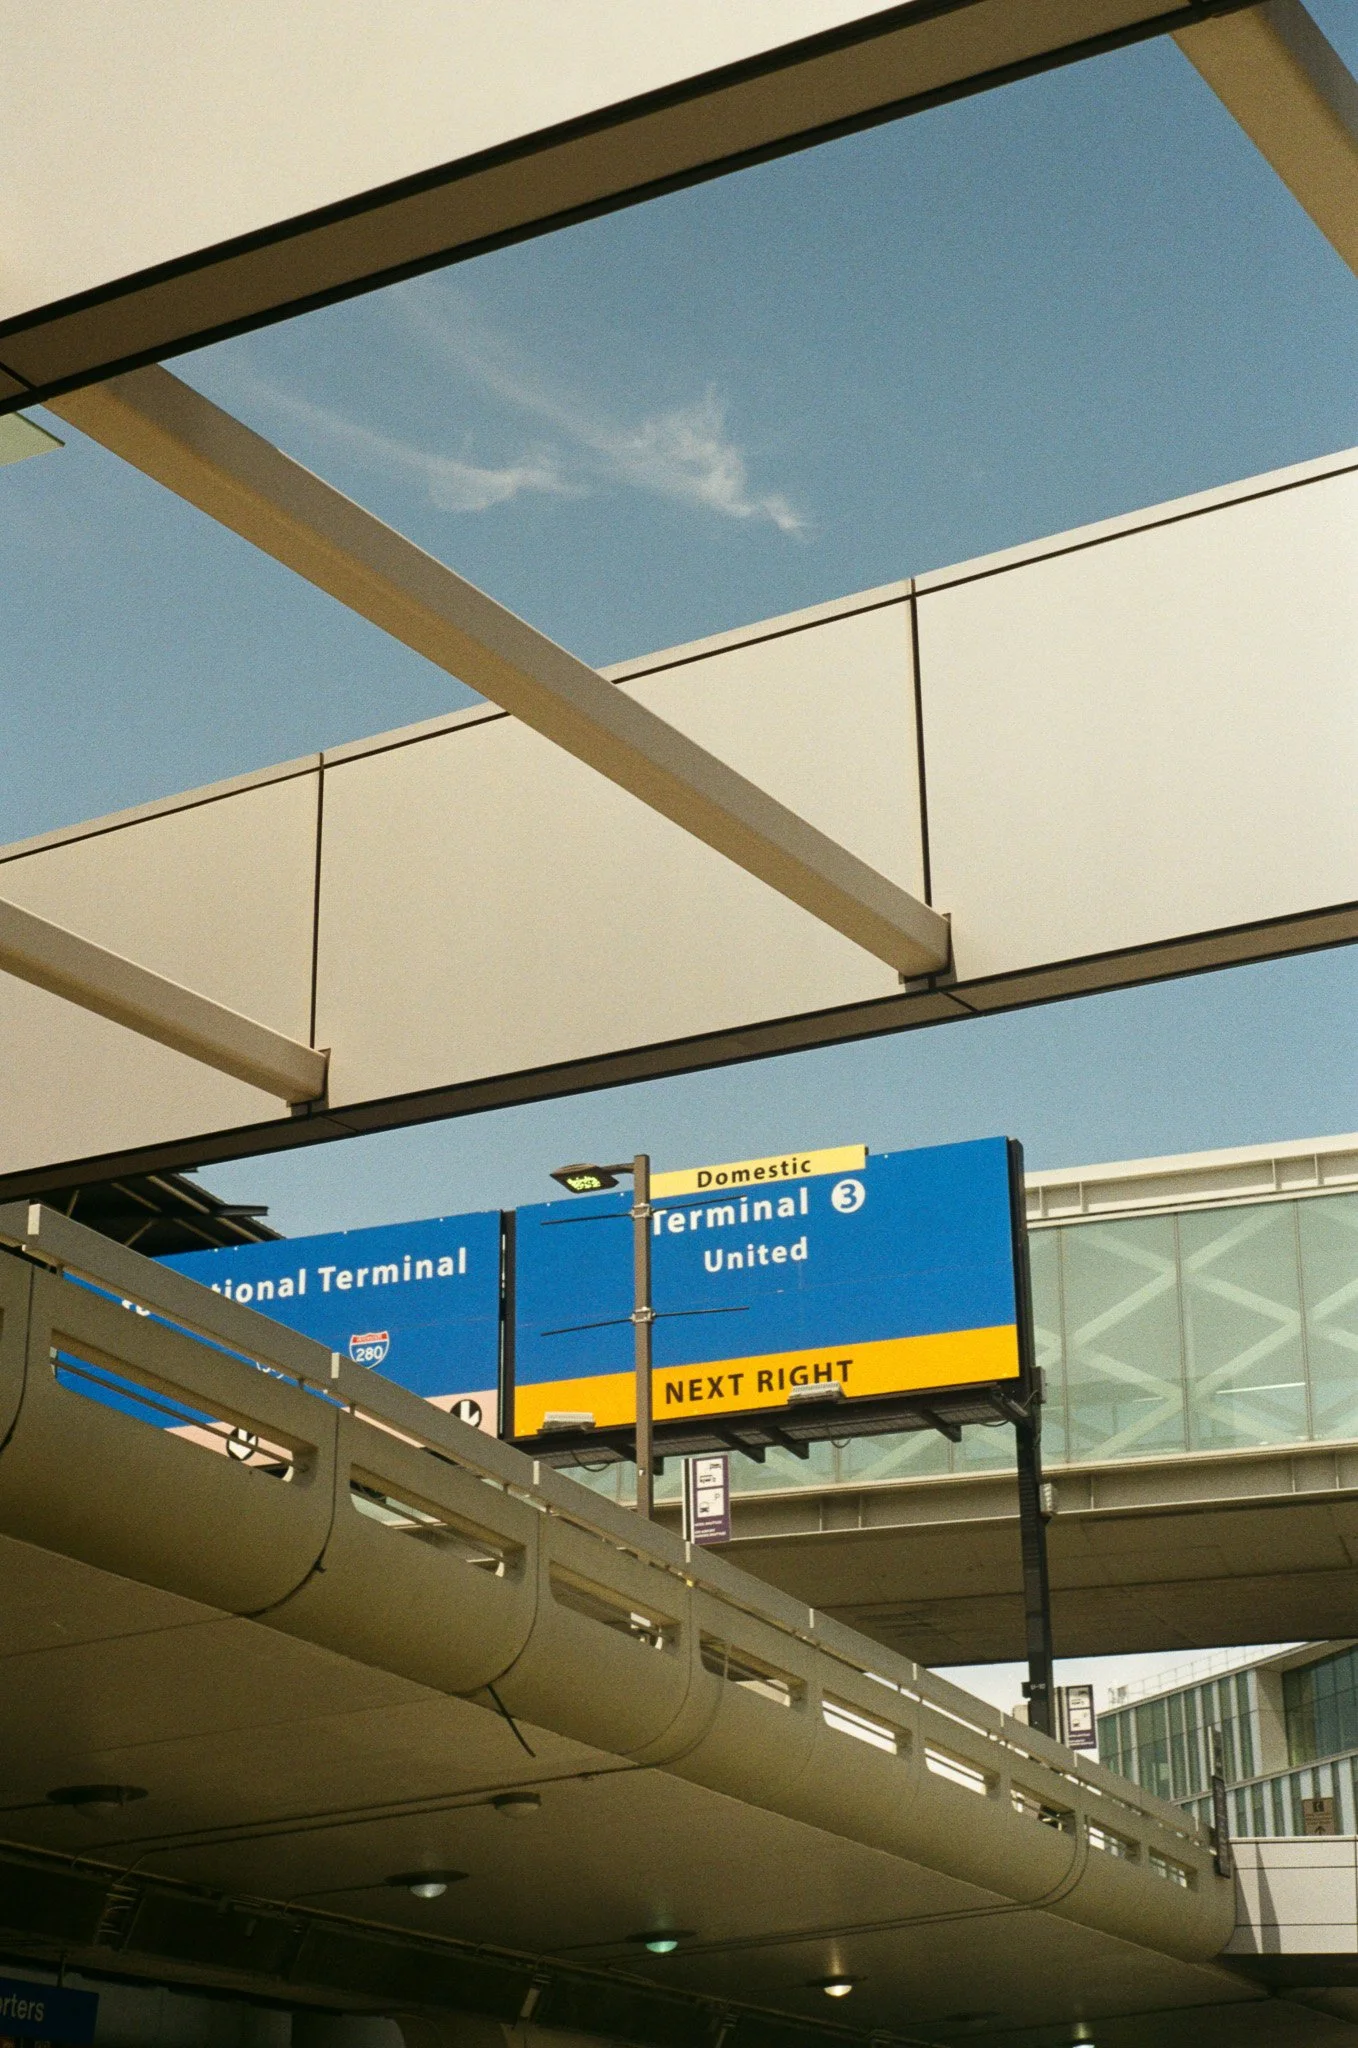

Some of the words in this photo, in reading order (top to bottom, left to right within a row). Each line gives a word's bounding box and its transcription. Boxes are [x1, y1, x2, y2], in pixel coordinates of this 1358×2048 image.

[697, 1158, 811, 1189] Domestic
[653, 1187, 808, 1236] Terminal
[318, 1247, 466, 1292] Terminal
[704, 1236, 808, 1273] United
[356, 1345, 383, 1362] 280
[665, 1373, 744, 1404] NEXT
[757, 1360, 853, 1393] RIGHT
